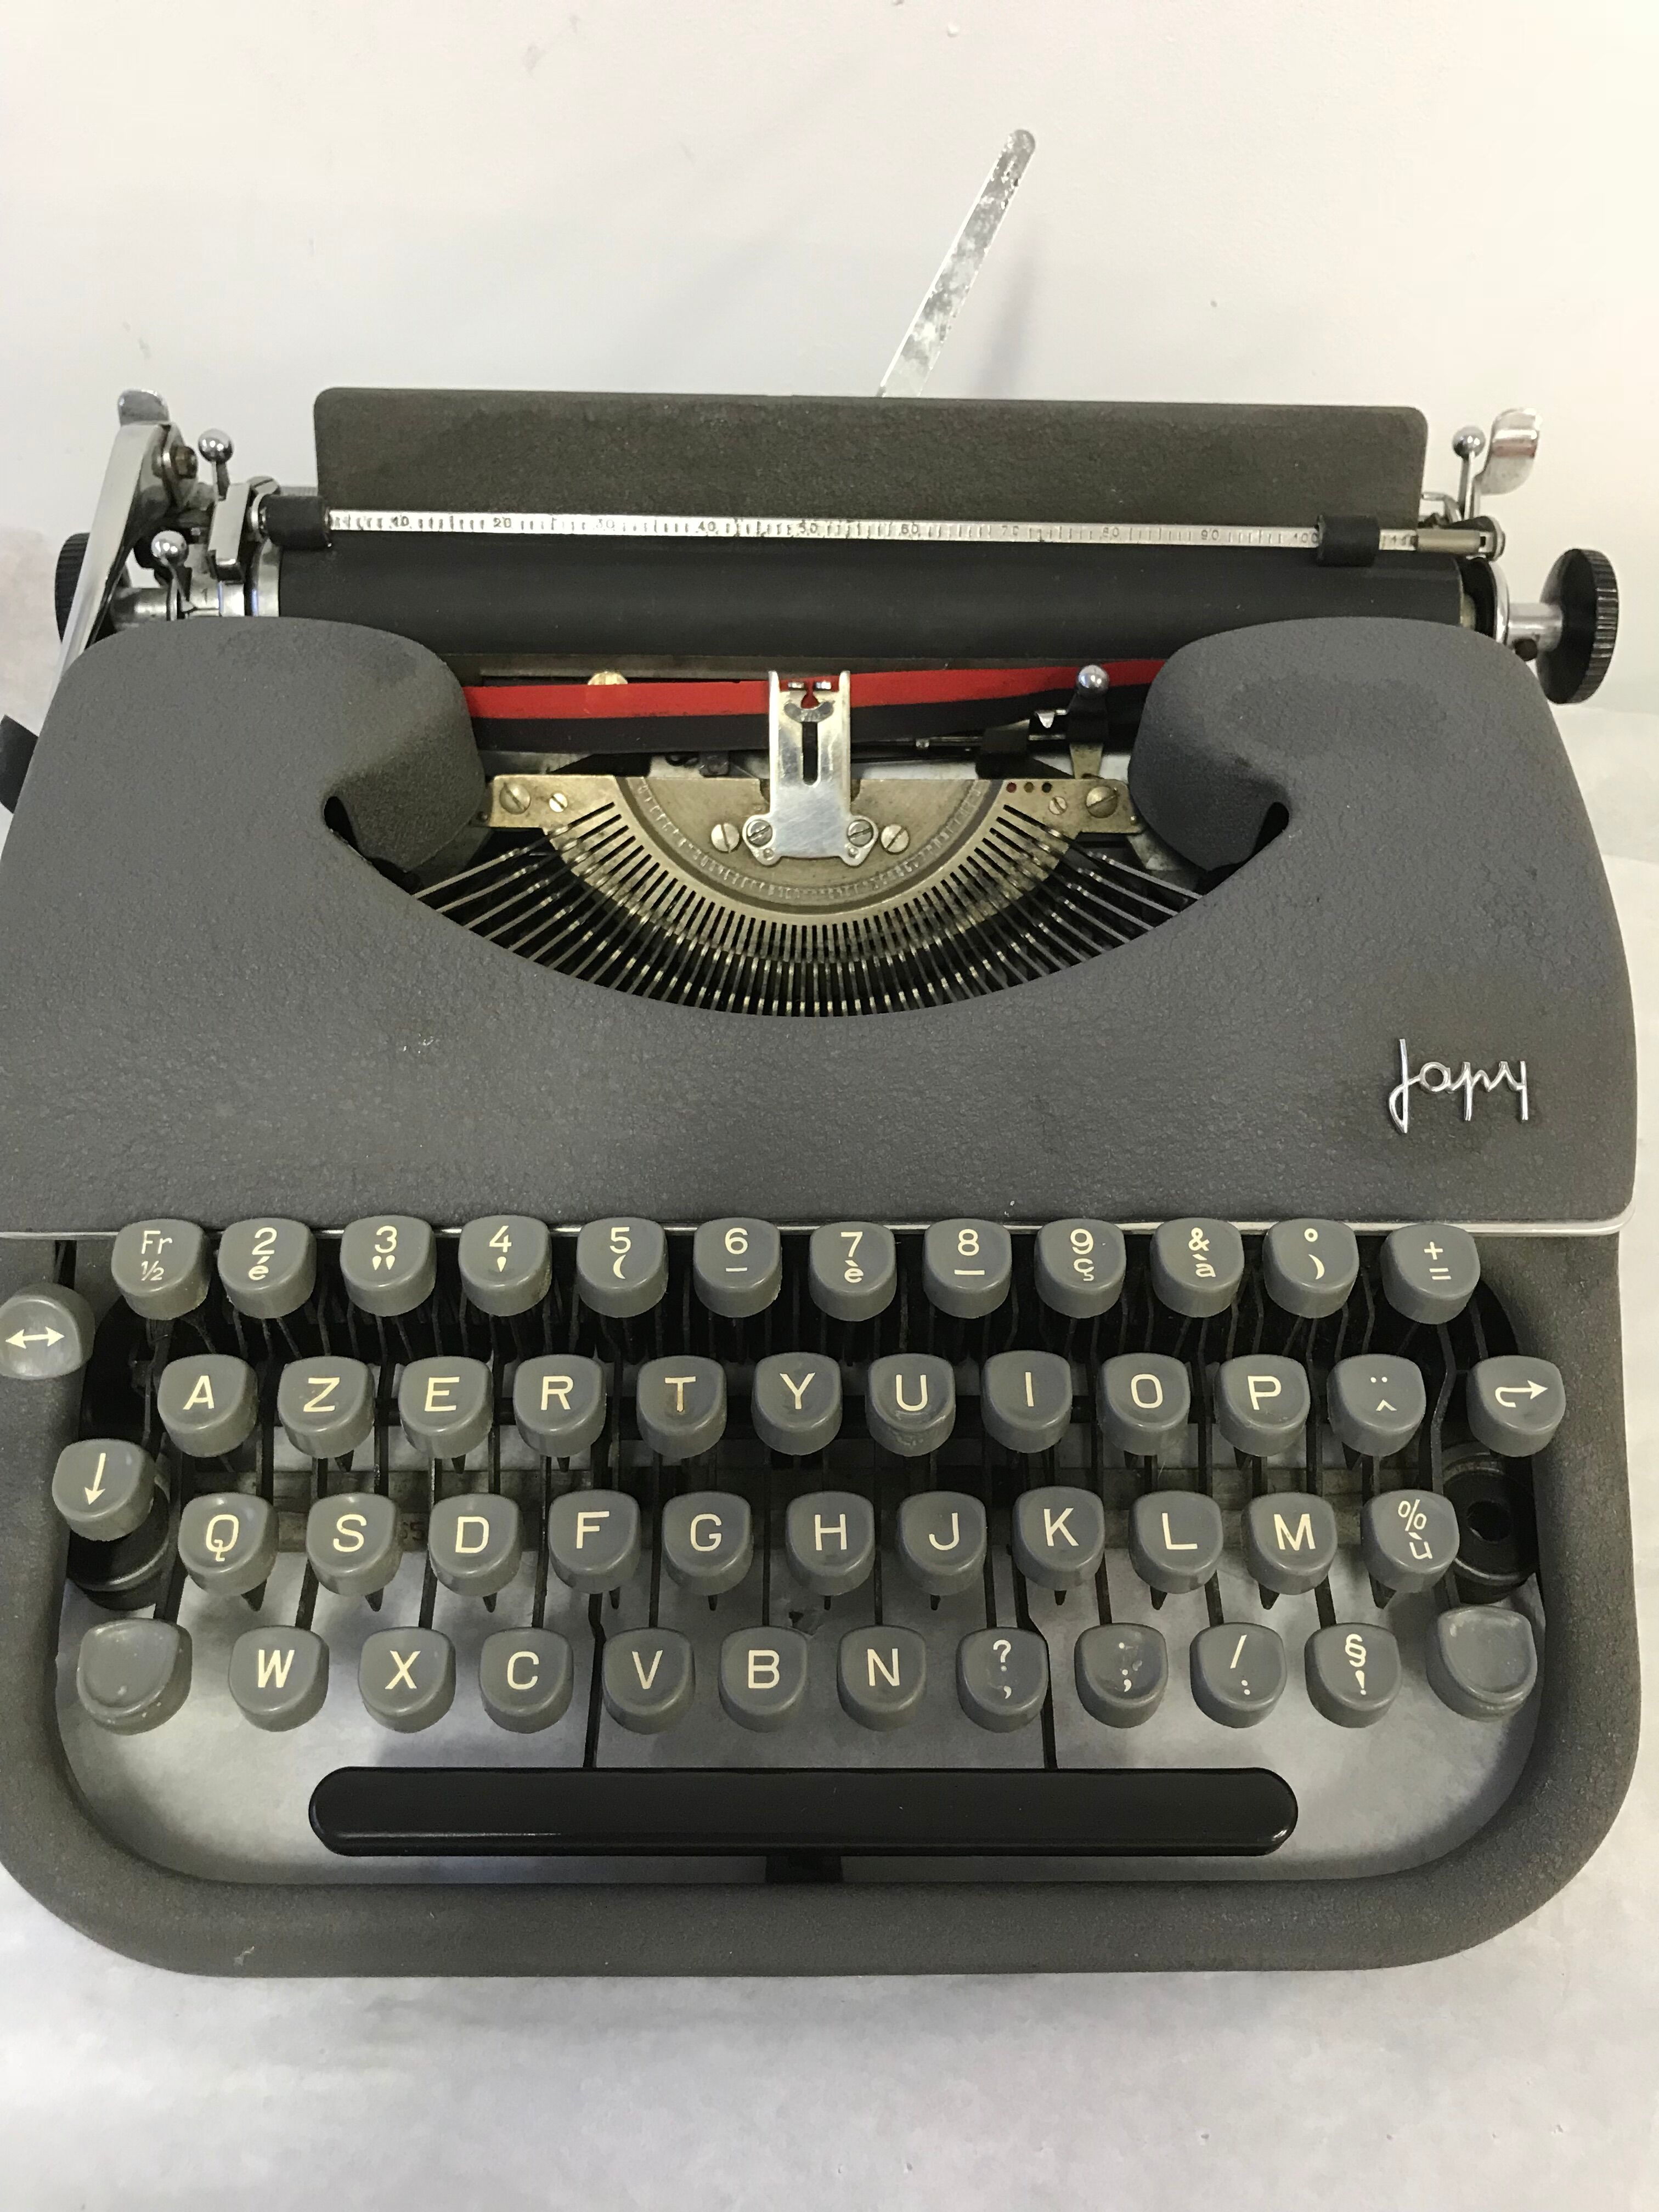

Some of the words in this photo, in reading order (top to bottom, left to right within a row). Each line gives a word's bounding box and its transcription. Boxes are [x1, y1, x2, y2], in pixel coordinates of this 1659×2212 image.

[392, 516, 410, 528] 10
[494, 517, 512, 528] 20
[596, 519, 616, 530] 30
[698, 521, 716, 532] 40
[799, 523, 817, 534] 50
[900, 523, 919, 534] 60
[1001, 525, 1019, 536] 70
[1201, 529, 1220, 541] 90
[1293, 533, 1318, 544] 100
[141, 1230, 173, 1254] Fr
[251, 1227, 277, 1255] 2
[374, 1225, 397, 1254] 3
[489, 1225, 512, 1253] 4
[610, 1227, 631, 1254] 5
[725, 1227, 748, 1255] 6
[840, 1231, 863, 1257] 7
[957, 1228, 979, 1256] 8
[1070, 1228, 1094, 1255] 9
[1188, 1227, 1210, 1251] &
[1424, 1242, 1443, 1260] +
[248, 1256, 270, 1280] é
[844, 1260, 864, 1283] è
[1073, 1258, 1094, 1281] ç
[1192, 1254, 1216, 1277] à
[1429, 1267, 1452, 1280] =
[183, 1375, 215, 1410] A
[303, 1377, 340, 1412] Z
[424, 1376, 460, 1412] E
[540, 1375, 573, 1410] R
[664, 1376, 696, 1412] T
[779, 1372, 816, 1409] Y
[895, 1374, 928, 1412] U
[1025, 1372, 1034, 1407] I
[1131, 1374, 1163, 1408] O
[1248, 1375, 1282, 1410] P
[576, 1511, 610, 1549] F
[690, 1514, 722, 1551] G
[815, 1514, 847, 1551] H
[929, 1513, 960, 1550] J
[1043, 1508, 1079, 1547] K
[1162, 1513, 1198, 1550] L
[1273, 1513, 1316, 1551] M
[1398, 1499, 1427, 1532] %
[205, 1514, 239, 1562] Q
[333, 1514, 367, 1553] S
[455, 1516, 489, 1554] D
[1408, 1532, 1433, 1560] ù
[867, 1648, 900, 1686] N
[993, 1639, 1012, 1671] ?
[1230, 1634, 1247, 1669] /
[1345, 1633, 1367, 1667] §
[257, 1649, 295, 1688] W
[385, 1650, 421, 1690] X
[507, 1651, 539, 1690] C
[631, 1650, 663, 1690] V
[748, 1650, 780, 1689] B
[1355, 1670, 1367, 1695] !
